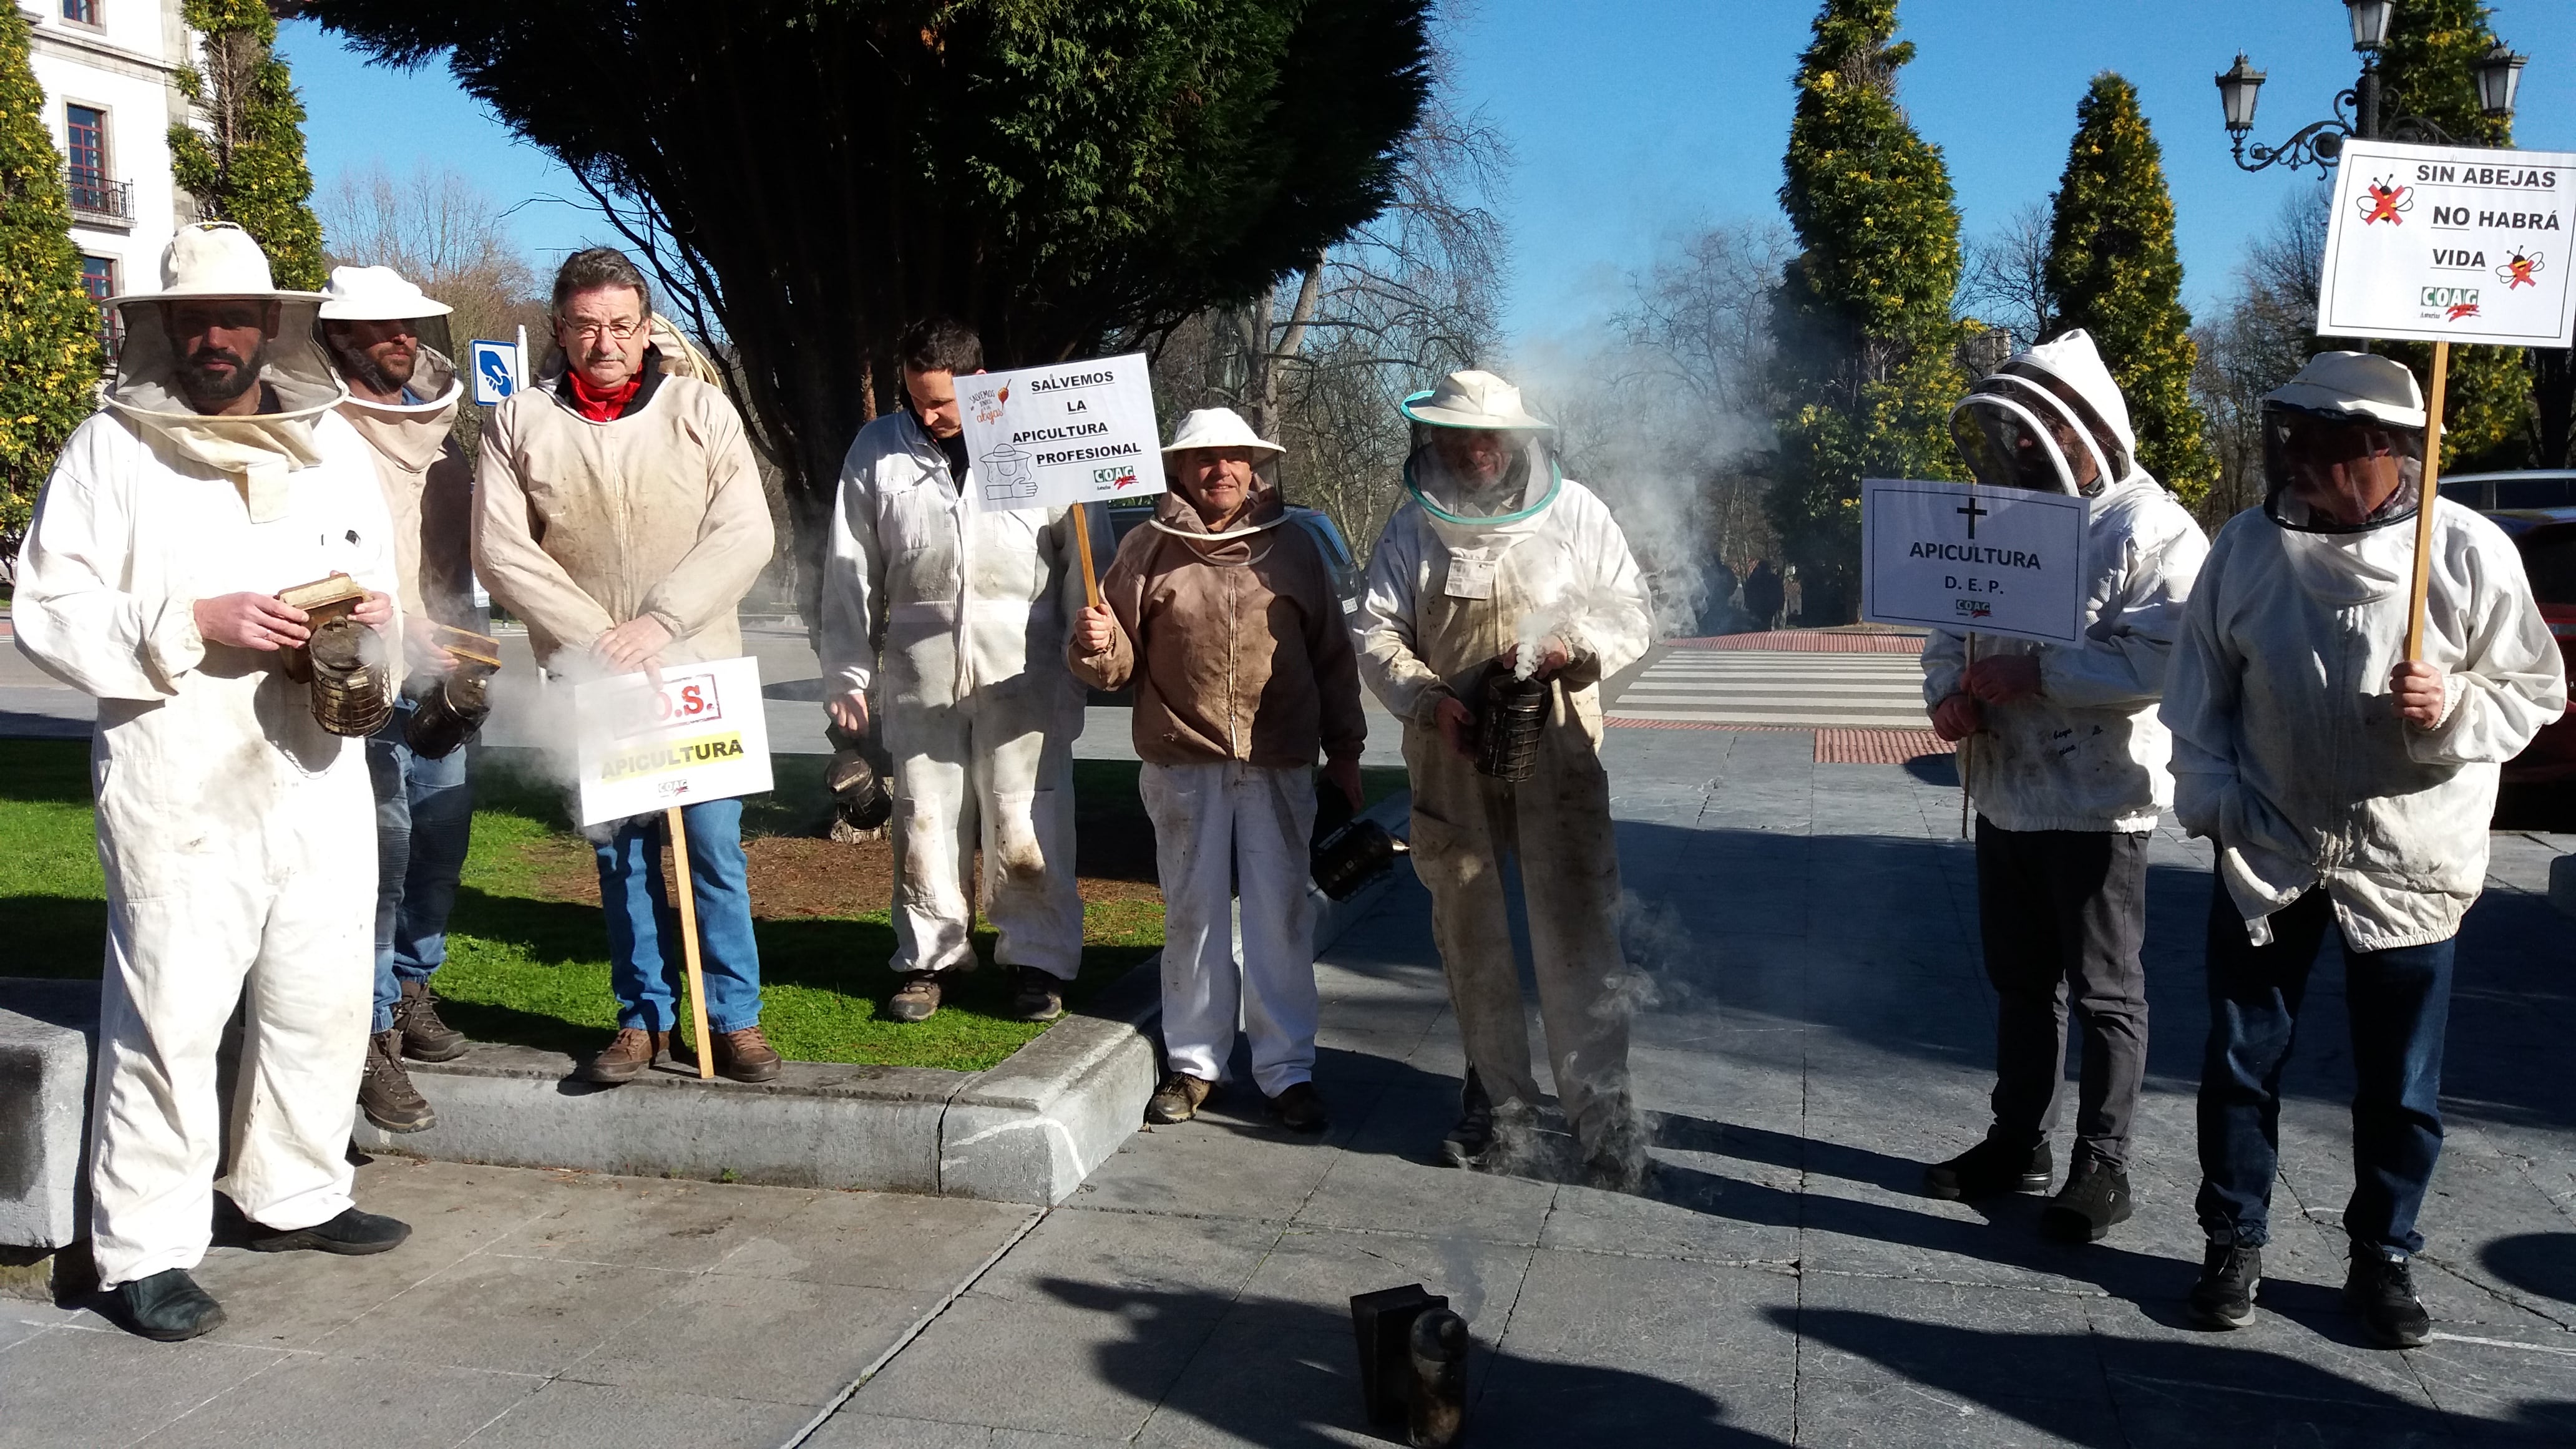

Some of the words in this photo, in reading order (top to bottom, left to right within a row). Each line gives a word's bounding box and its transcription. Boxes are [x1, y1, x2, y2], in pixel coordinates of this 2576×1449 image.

[2416, 164, 2455, 183] SIN
[2462, 167, 2556, 188] ABEJAS
[2433, 206, 2470, 226] NO
[2478, 210, 2560, 231] HABRÁ
[2432, 248, 2486, 268] VIDA
[2422, 287, 2479, 307] COAG
[1031, 371, 1114, 391] SALVEMOS
[969, 389, 995, 404] SALVEMOS
[1067, 399, 1087, 412] LA
[977, 408, 1003, 425] abejas
[1012, 422, 1108, 443] APICULTURA
[1036, 442, 1142, 465] PROFESIONAL
[1095, 466, 1134, 482] COAG
[1909, 542, 2041, 570] APICULTURA
[1945, 575, 1962, 590] D.
[1968, 578, 1983, 592] E.
[1989, 580, 2004, 594] P.
[1956, 600, 1990, 611] COAG
[601, 739, 744, 779] APICULTURA
